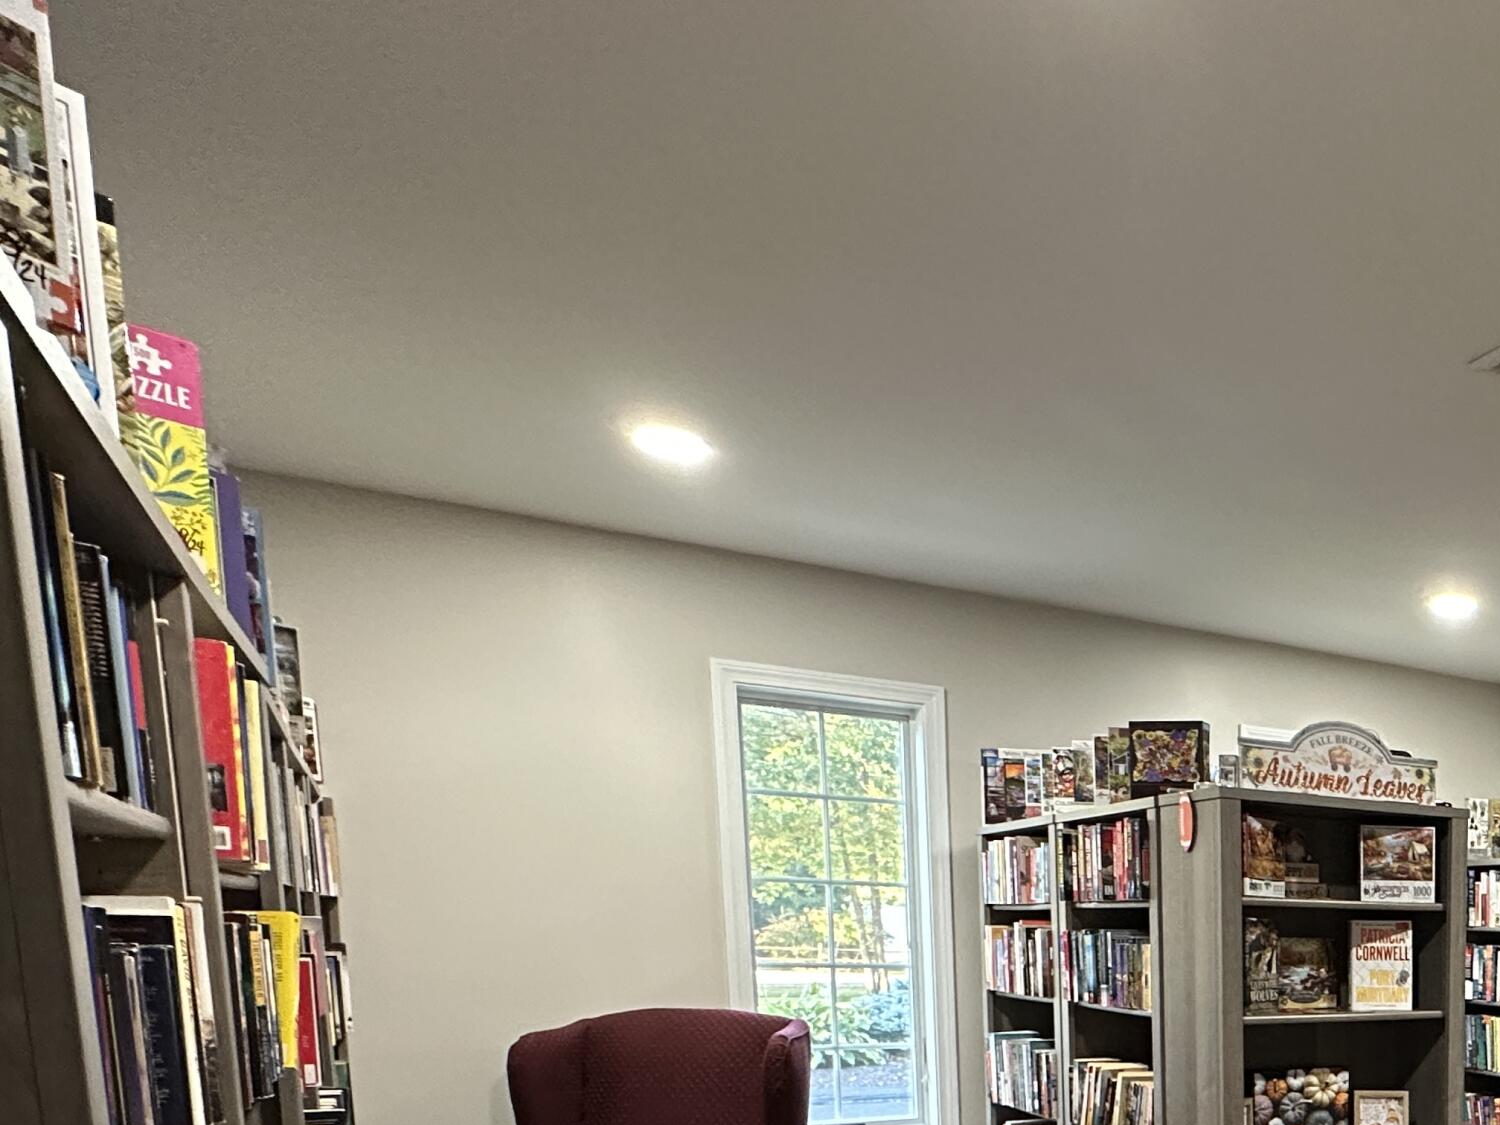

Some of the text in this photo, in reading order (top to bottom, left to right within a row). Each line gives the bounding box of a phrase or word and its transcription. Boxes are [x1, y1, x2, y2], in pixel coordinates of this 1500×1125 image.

[1310, 735, 1373, 754] FALL BREEZE
[1255, 755, 1351, 794] Autumn
[1413, 886, 1432, 897] 1000
[1360, 927, 1407, 944] PATRICIA
[1355, 945, 1410, 962] CORNWELL
